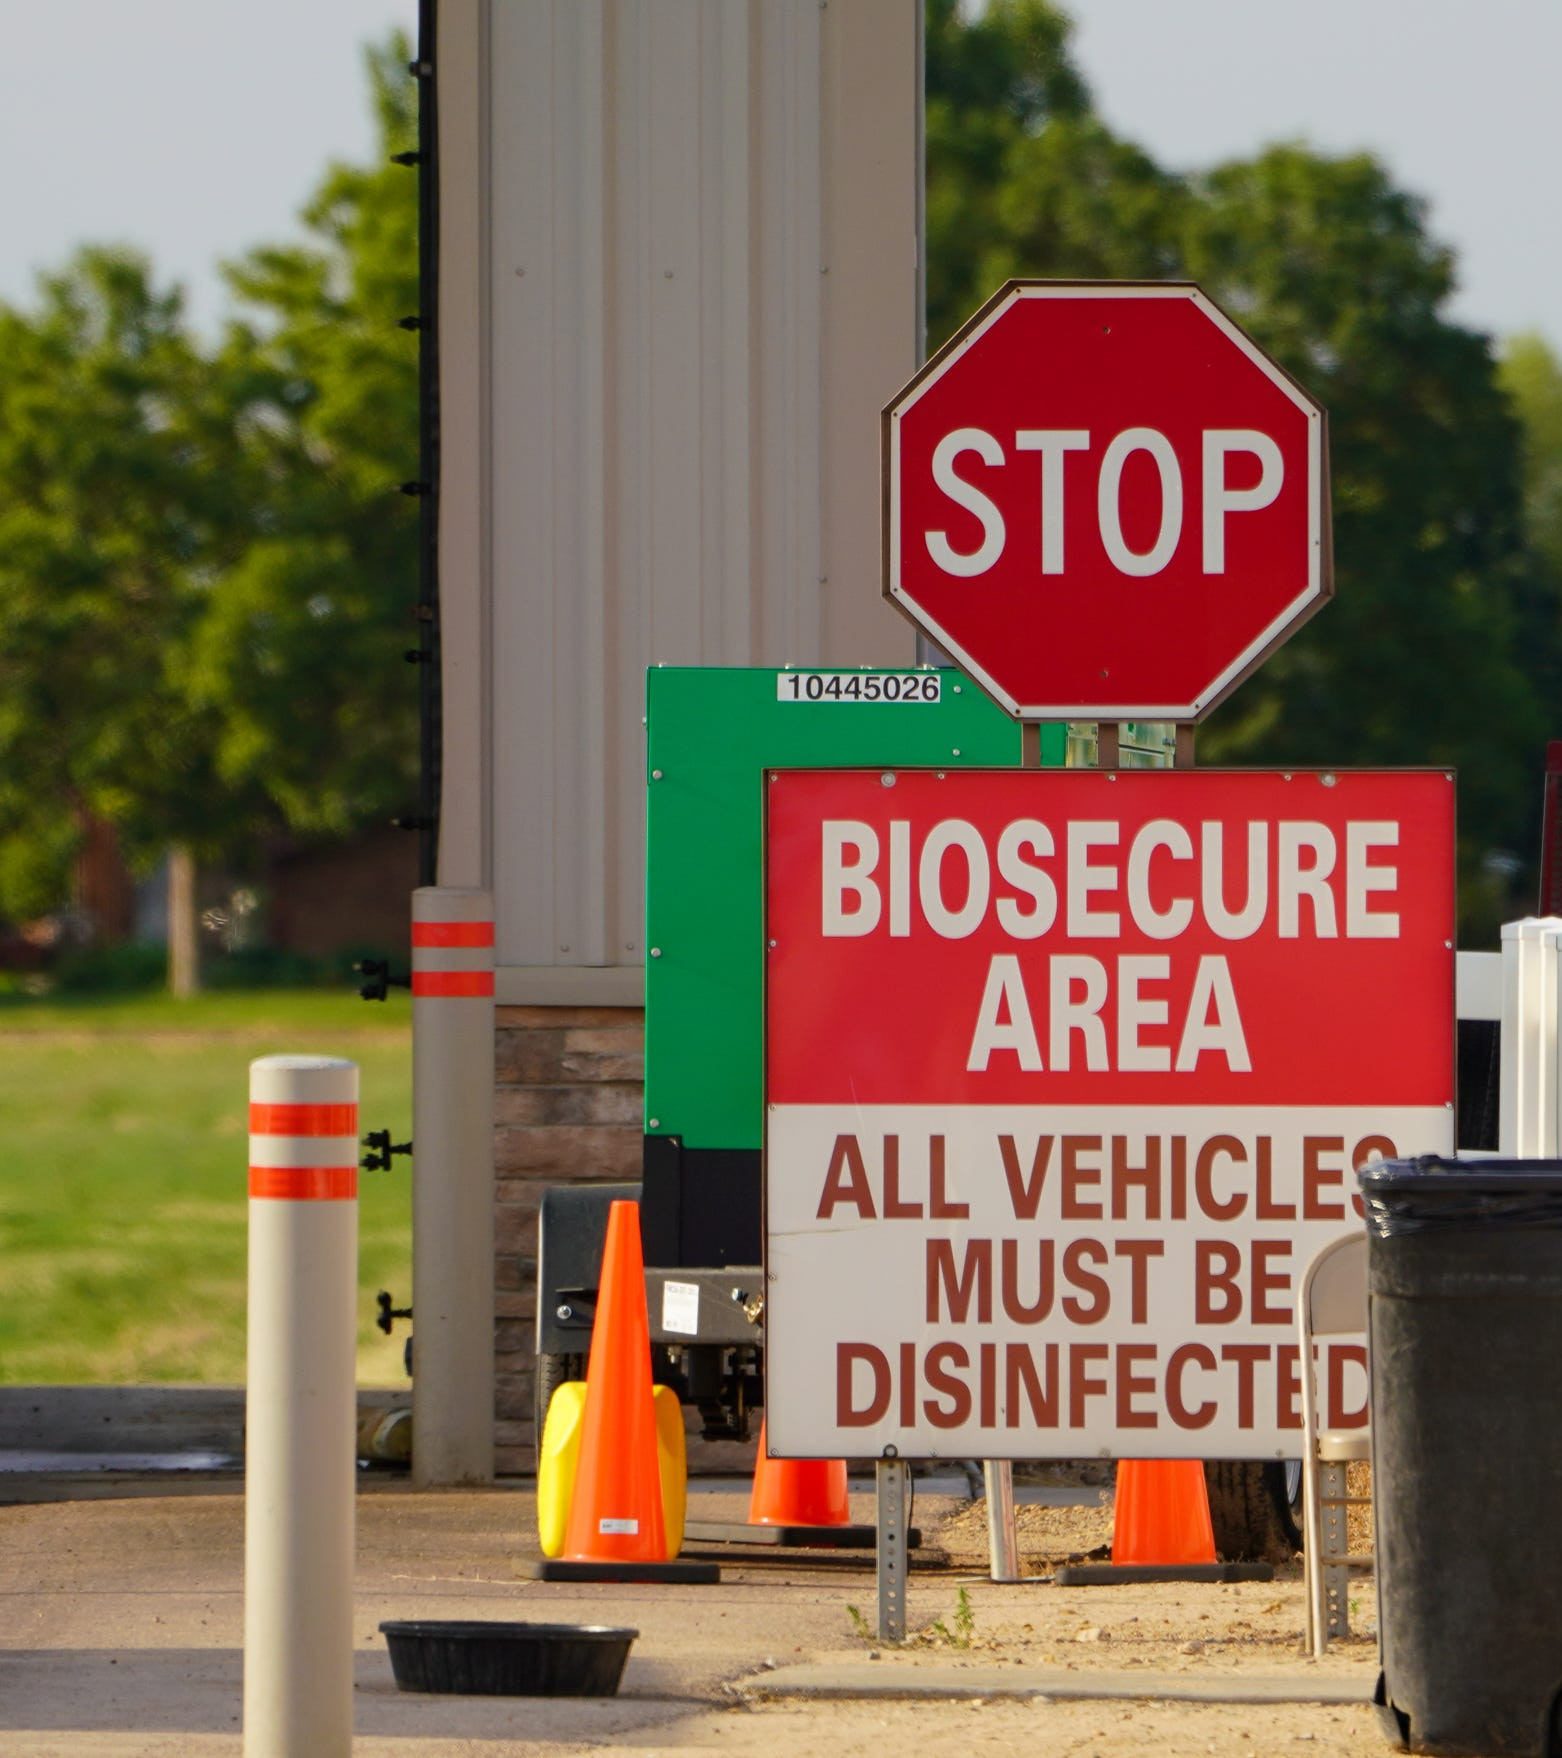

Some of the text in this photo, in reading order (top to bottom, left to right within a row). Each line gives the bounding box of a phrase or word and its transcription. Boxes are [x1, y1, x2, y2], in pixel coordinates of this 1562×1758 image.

[924, 428, 1284, 577] STOP
[788, 674, 939, 701] 10445026
[822, 819, 1400, 941] BIOSECURE
[967, 955, 1253, 1073] AREA
[817, 1135, 970, 1220] ALL
[926, 1239, 1294, 1326] MUST BE
[837, 1342, 1370, 1430] DISINFECTED
